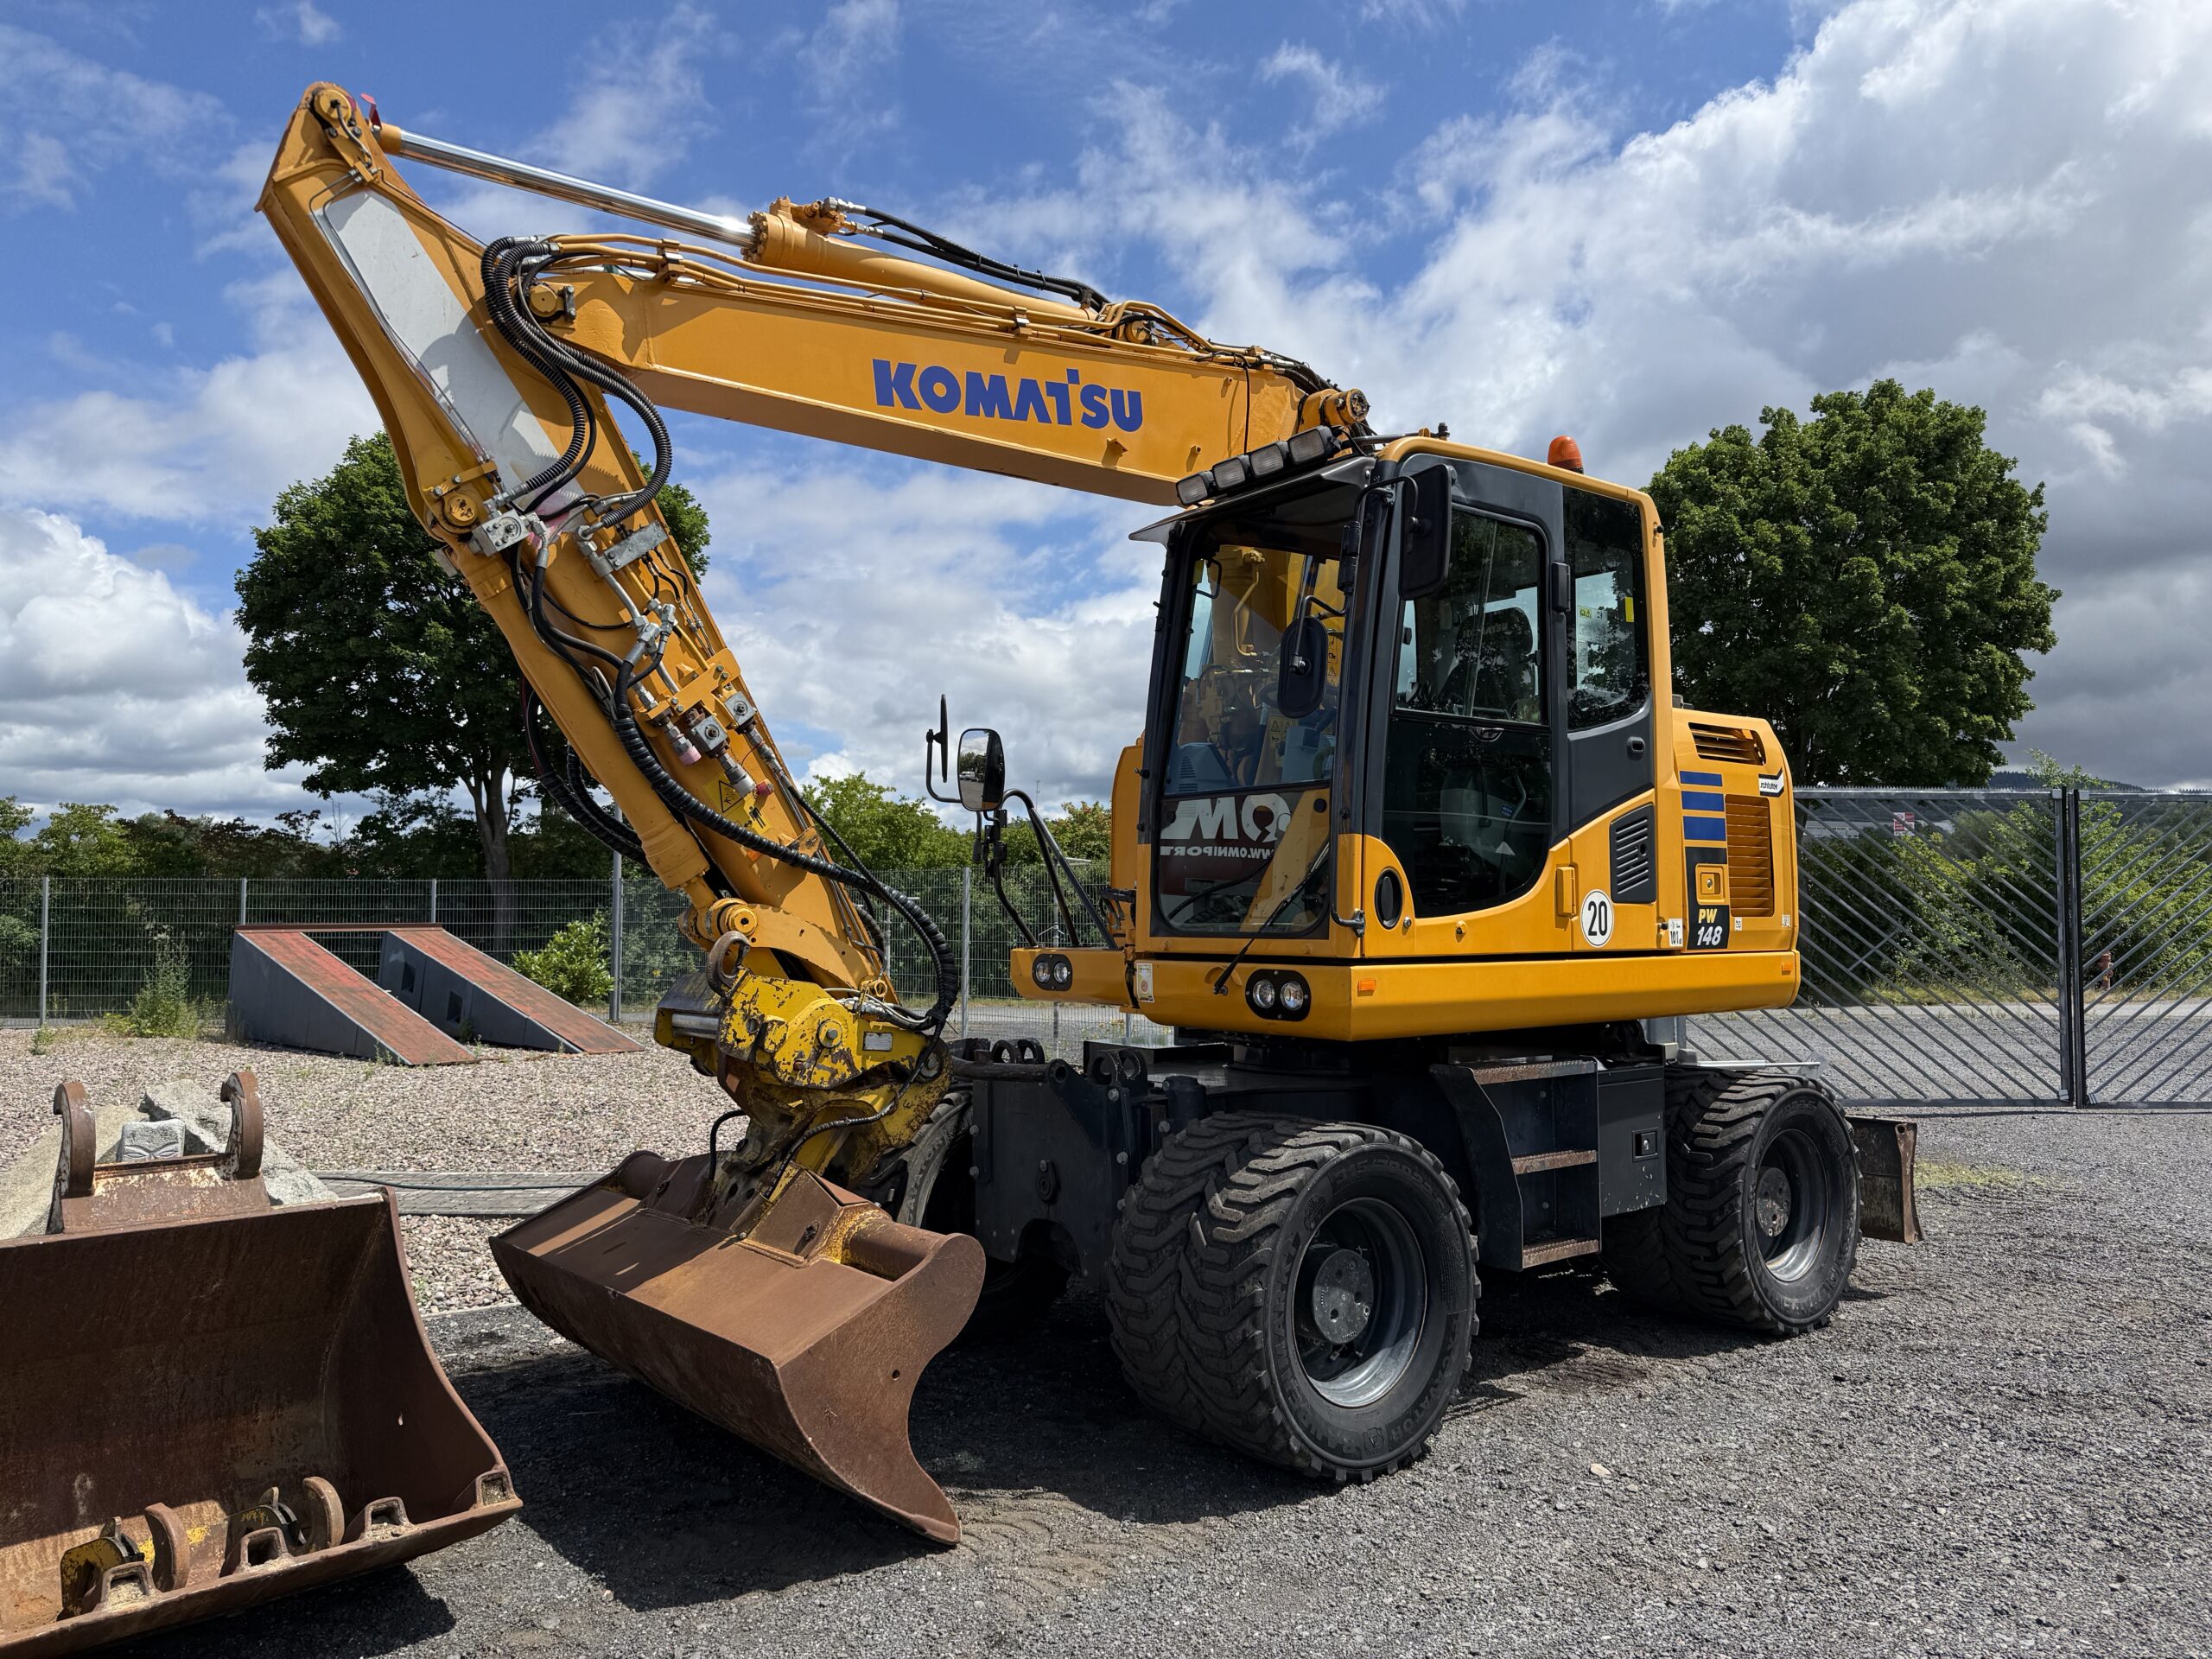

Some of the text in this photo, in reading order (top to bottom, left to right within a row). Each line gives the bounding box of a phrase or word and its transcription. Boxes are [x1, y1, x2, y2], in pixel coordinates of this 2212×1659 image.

[872, 359, 1143, 432] KOMATSU
[1587, 900, 1607, 936] 20
[1698, 908, 1718, 924] PW
[1696, 925, 1723, 946] 148
[906, 1133, 944, 1225] CAVATOR
